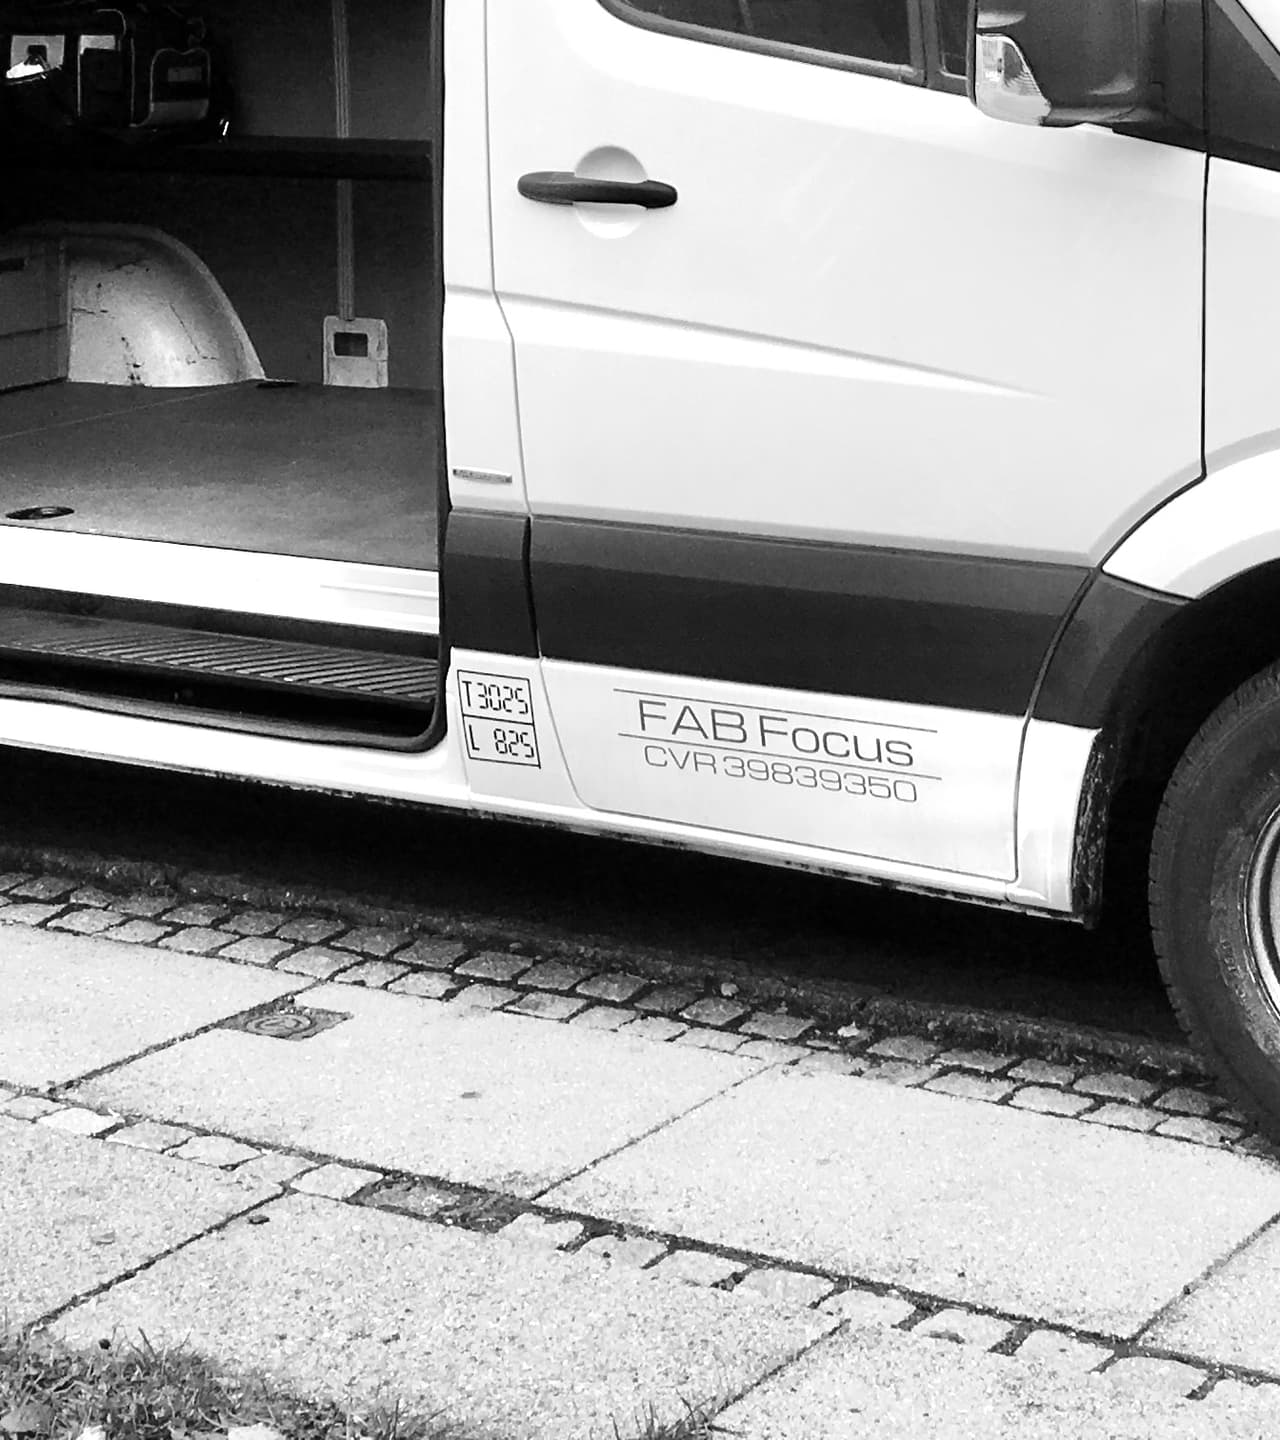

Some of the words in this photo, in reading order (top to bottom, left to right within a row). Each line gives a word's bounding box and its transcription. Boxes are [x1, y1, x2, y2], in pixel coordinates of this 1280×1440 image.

[461, 680, 529, 715] T3025
[639, 698, 747, 744] FAB
[468, 724, 480, 751] L
[493, 728, 535, 758] 825
